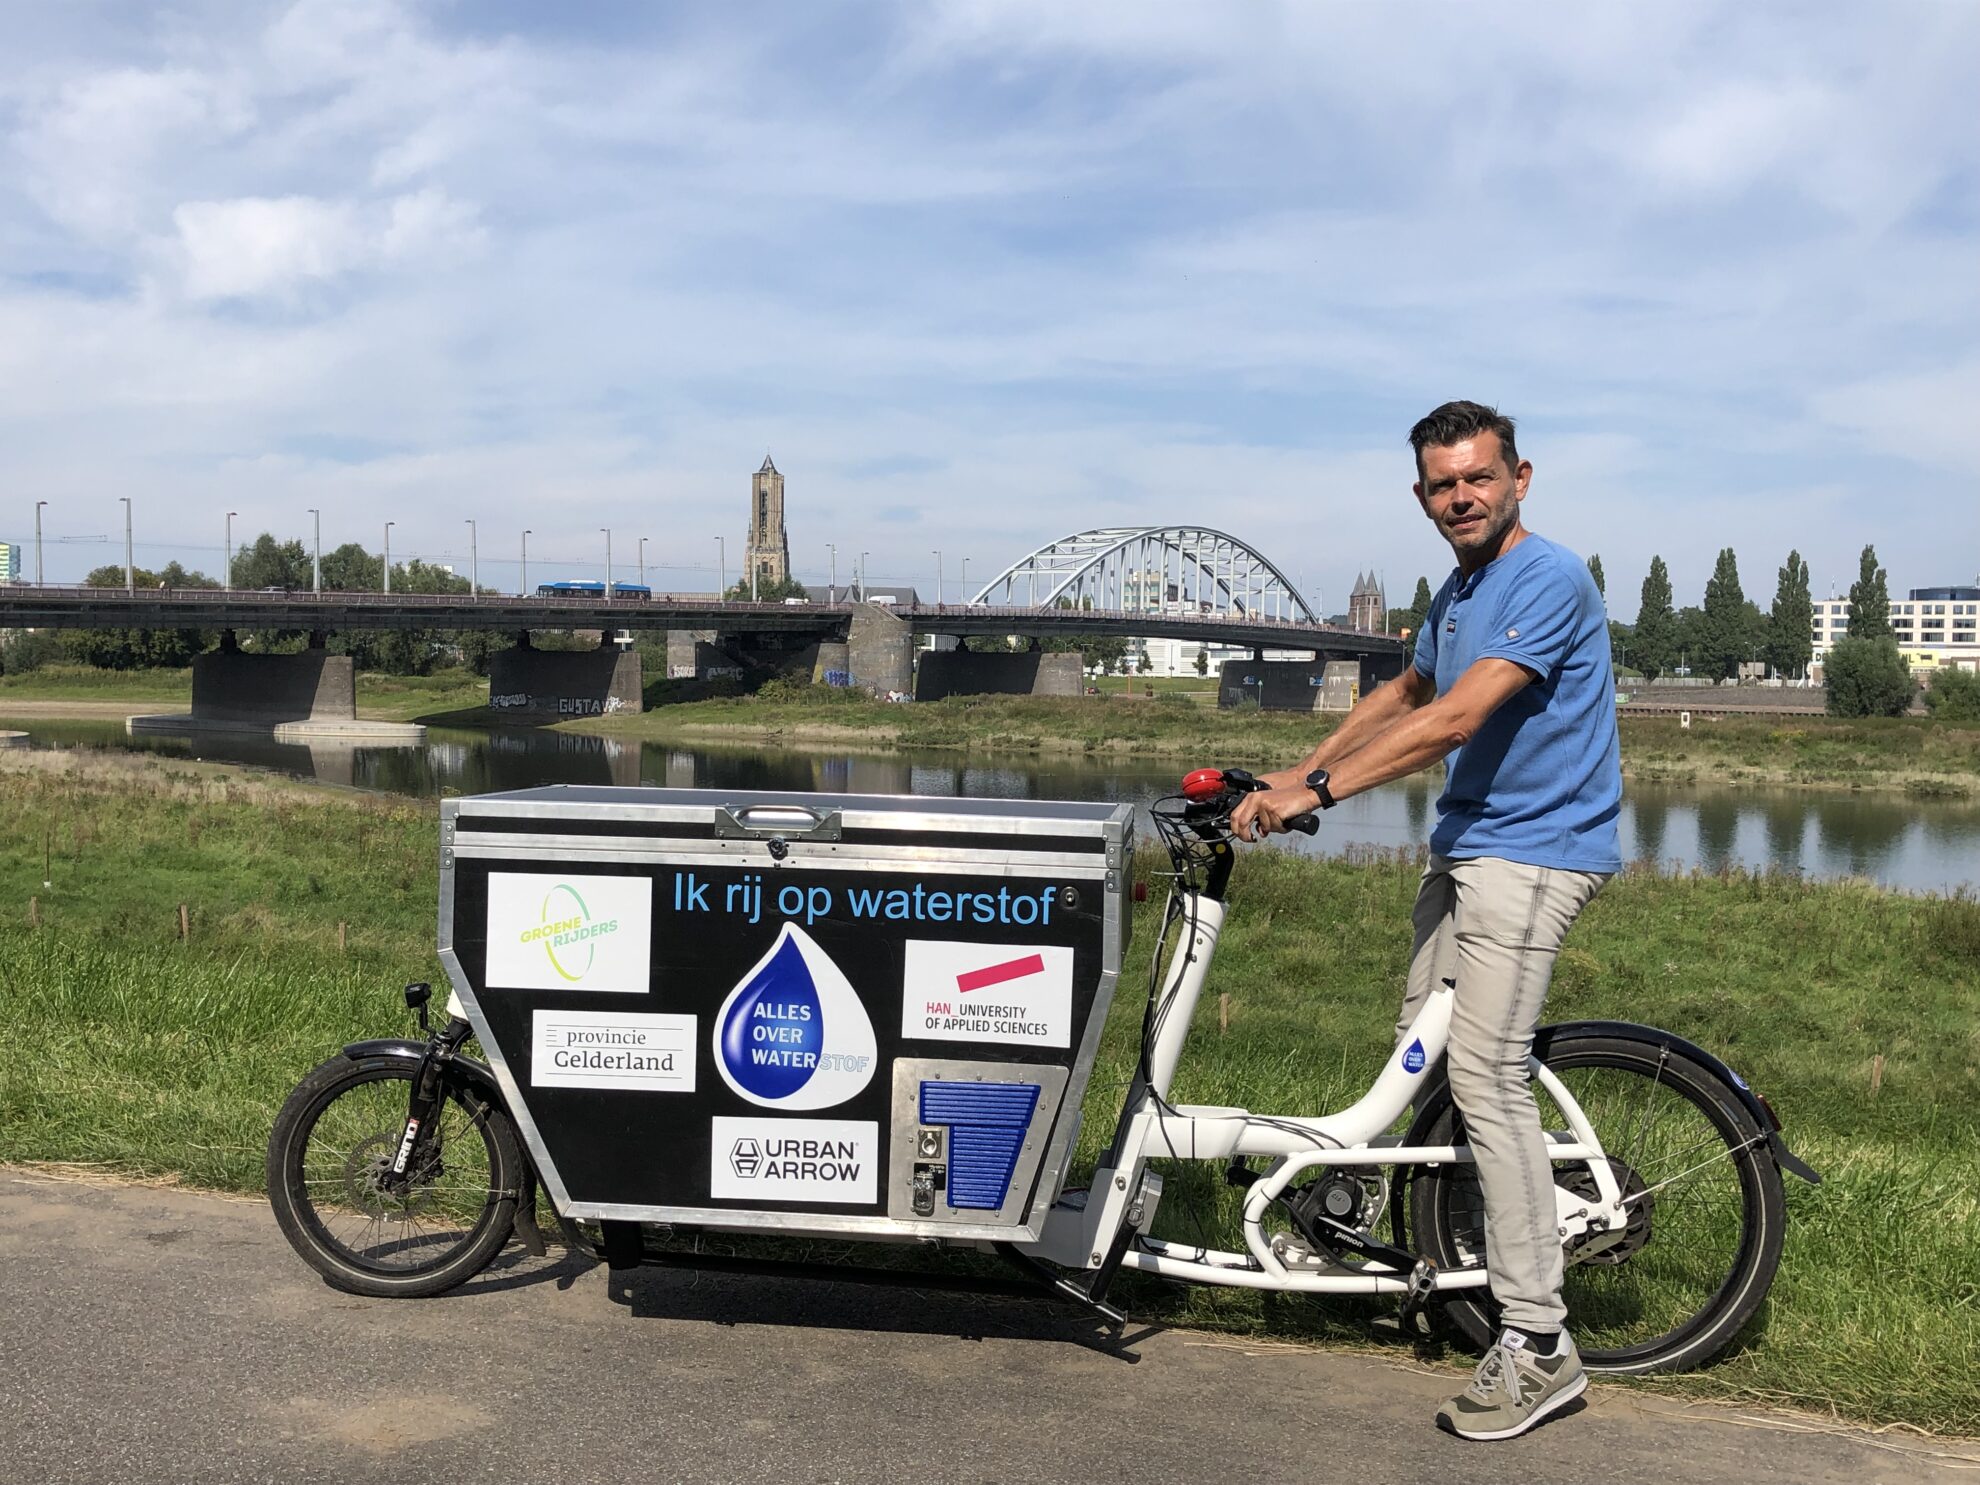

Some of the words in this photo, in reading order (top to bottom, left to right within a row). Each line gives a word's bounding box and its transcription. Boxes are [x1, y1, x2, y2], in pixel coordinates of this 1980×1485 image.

[675, 872, 710, 912] Ik
[726, 875, 761, 924] rij
[778, 885, 832, 926] op
[847, 882, 1057, 925] waterstof
[520, 916, 582, 943] GROENE
[553, 919, 618, 948] RIJDERS
[753, 1002, 812, 1021] ALLES
[960, 1003, 1027, 1019] UNIVERSITY
[753, 1025, 803, 1044] OVER
[925, 1016, 941, 1030] OF
[943, 1018, 990, 1033] APPLIED
[993, 1020, 1048, 1036] SCIENCES
[566, 1028, 647, 1047] provincie
[554, 1050, 674, 1071] Gelderland
[765, 1138, 854, 1160] URBAN
[764, 1160, 861, 1182] ARROW
[1334, 1231, 1364, 1248] pinion
